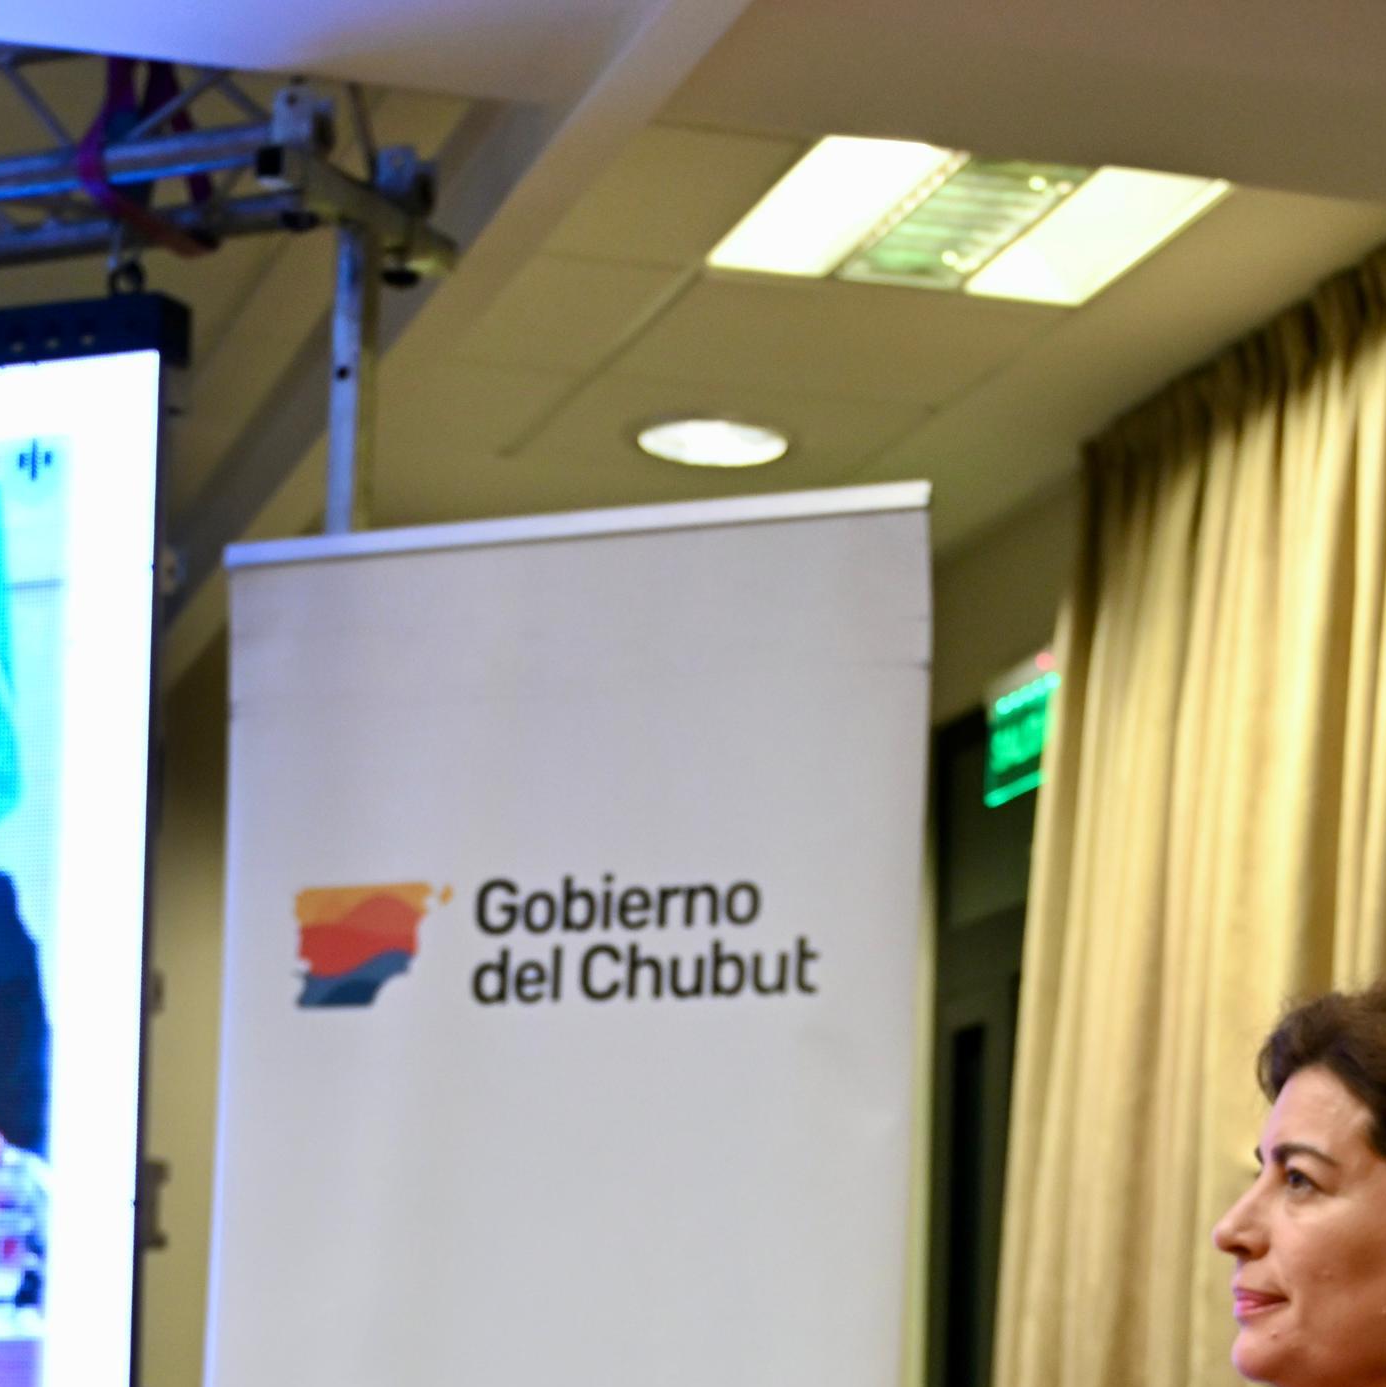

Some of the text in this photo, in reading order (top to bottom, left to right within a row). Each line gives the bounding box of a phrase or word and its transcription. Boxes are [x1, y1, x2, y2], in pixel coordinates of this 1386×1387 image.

[474, 874, 761, 936] Gobierno
[471, 936, 819, 1006] del Chubut
